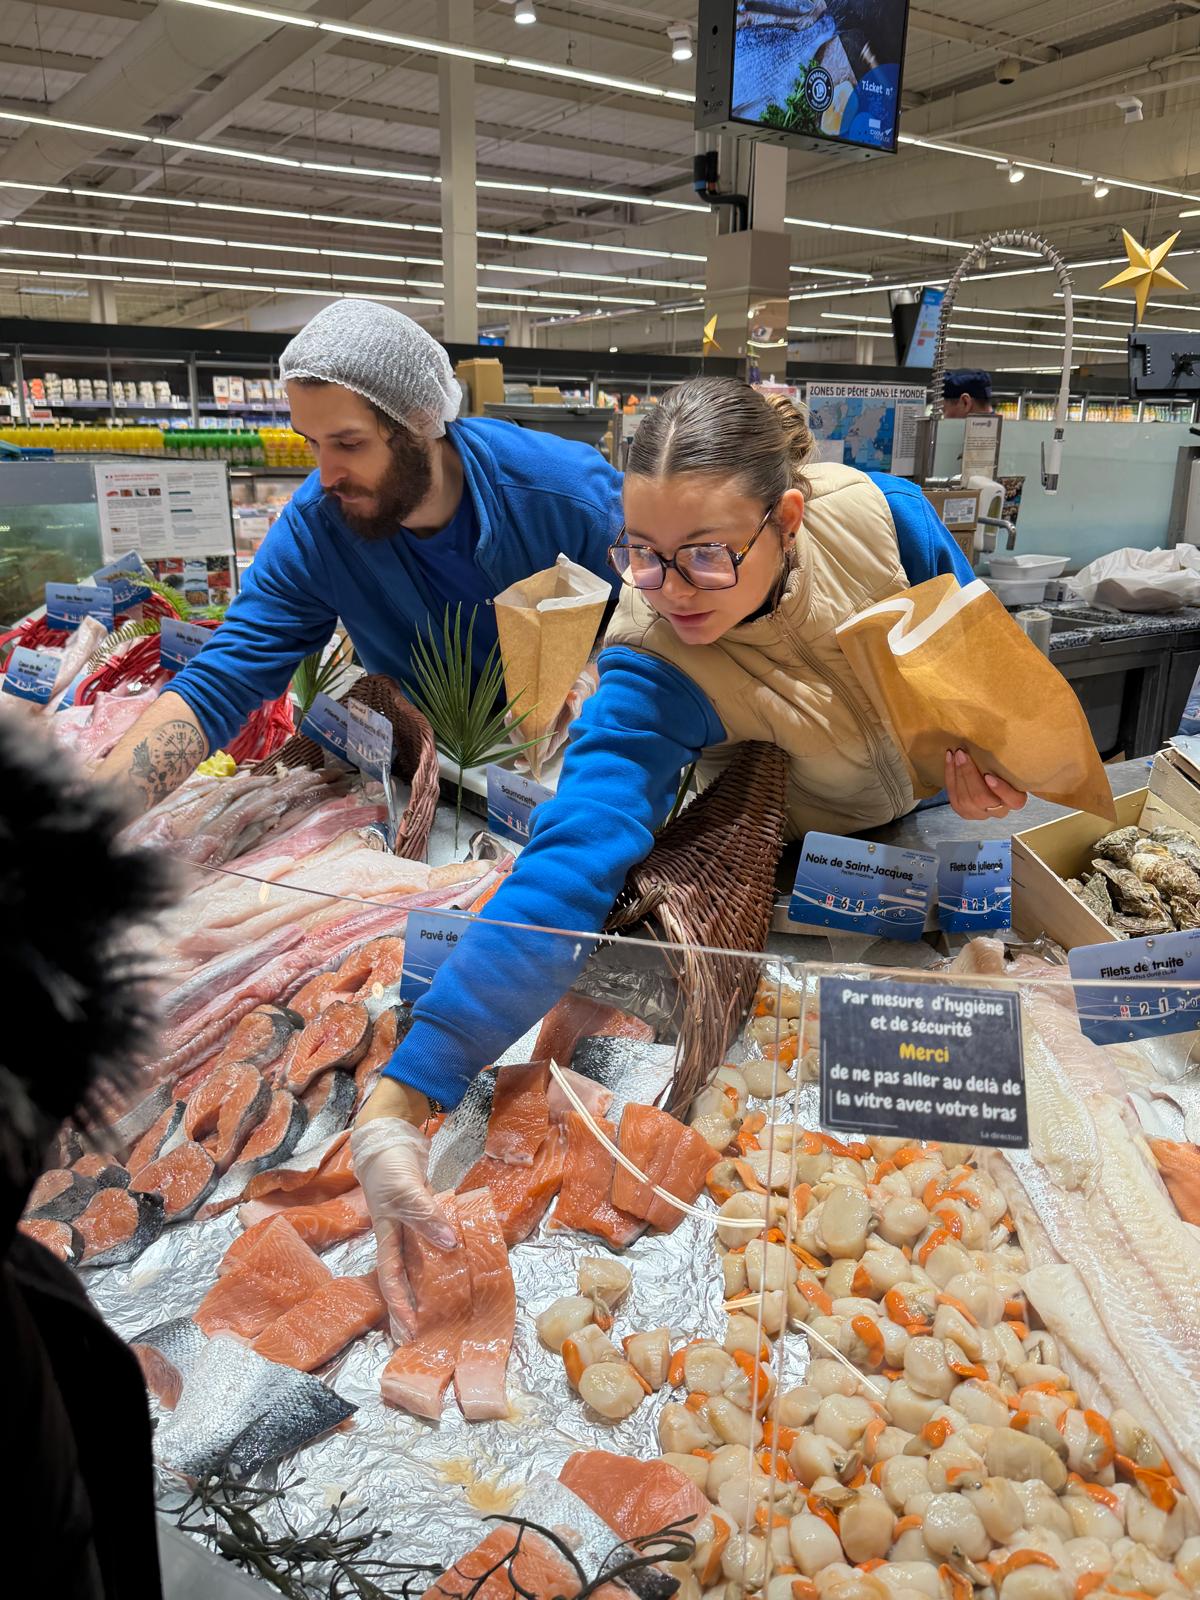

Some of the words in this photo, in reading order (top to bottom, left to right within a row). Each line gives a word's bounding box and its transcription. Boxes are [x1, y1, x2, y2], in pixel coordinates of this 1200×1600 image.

[862, 80, 883, 95] Ticket
[810, 386, 834, 396] ZONES
[836, 387, 845, 396] DE
[870, 388, 889, 398] DANS
[891, 389, 898, 398] LE
[900, 389, 925, 399] MONDE
[805, 852, 828, 866] Noix
[830, 857, 843, 868] de
[845, 860, 914, 882] Saint-Jacques
[950, 862, 967, 872] Filets
[967, 861, 977, 871] de
[420, 929, 443, 941] Pavé
[445, 930, 459, 942] de
[1100, 966, 1131, 979] Filets
[1133, 962, 1149, 973] de
[1152, 957, 1185, 970] truite
[842, 989, 869, 1005] Par
[871, 993, 924, 1009] mesure
[931, 996, 1005, 1018] d'hygiène
[870, 1015, 887, 1031] et
[889, 1016, 909, 1033] de
[911, 1019, 973, 1038] sécurité
[899, 1042, 950, 1063] Merci
[830, 1063, 849, 1080] de
[852, 1067, 871, 1082] ne
[874, 1071, 900, 1087] pas
[902, 1071, 940, 1088] aller
[942, 1076, 963, 1091] au
[965, 1075, 999, 1095] delà
[1002, 1079, 1022, 1096] de
[835, 1089, 851, 1106] la
[853, 1091, 893, 1110] vitre
[896, 1098, 933, 1114] avec
[935, 1101, 979, 1118] votre
[982, 1102, 1018, 1123] bras
[979, 1130, 990, 1139] La
[990, 1131, 1023, 1142] direction
